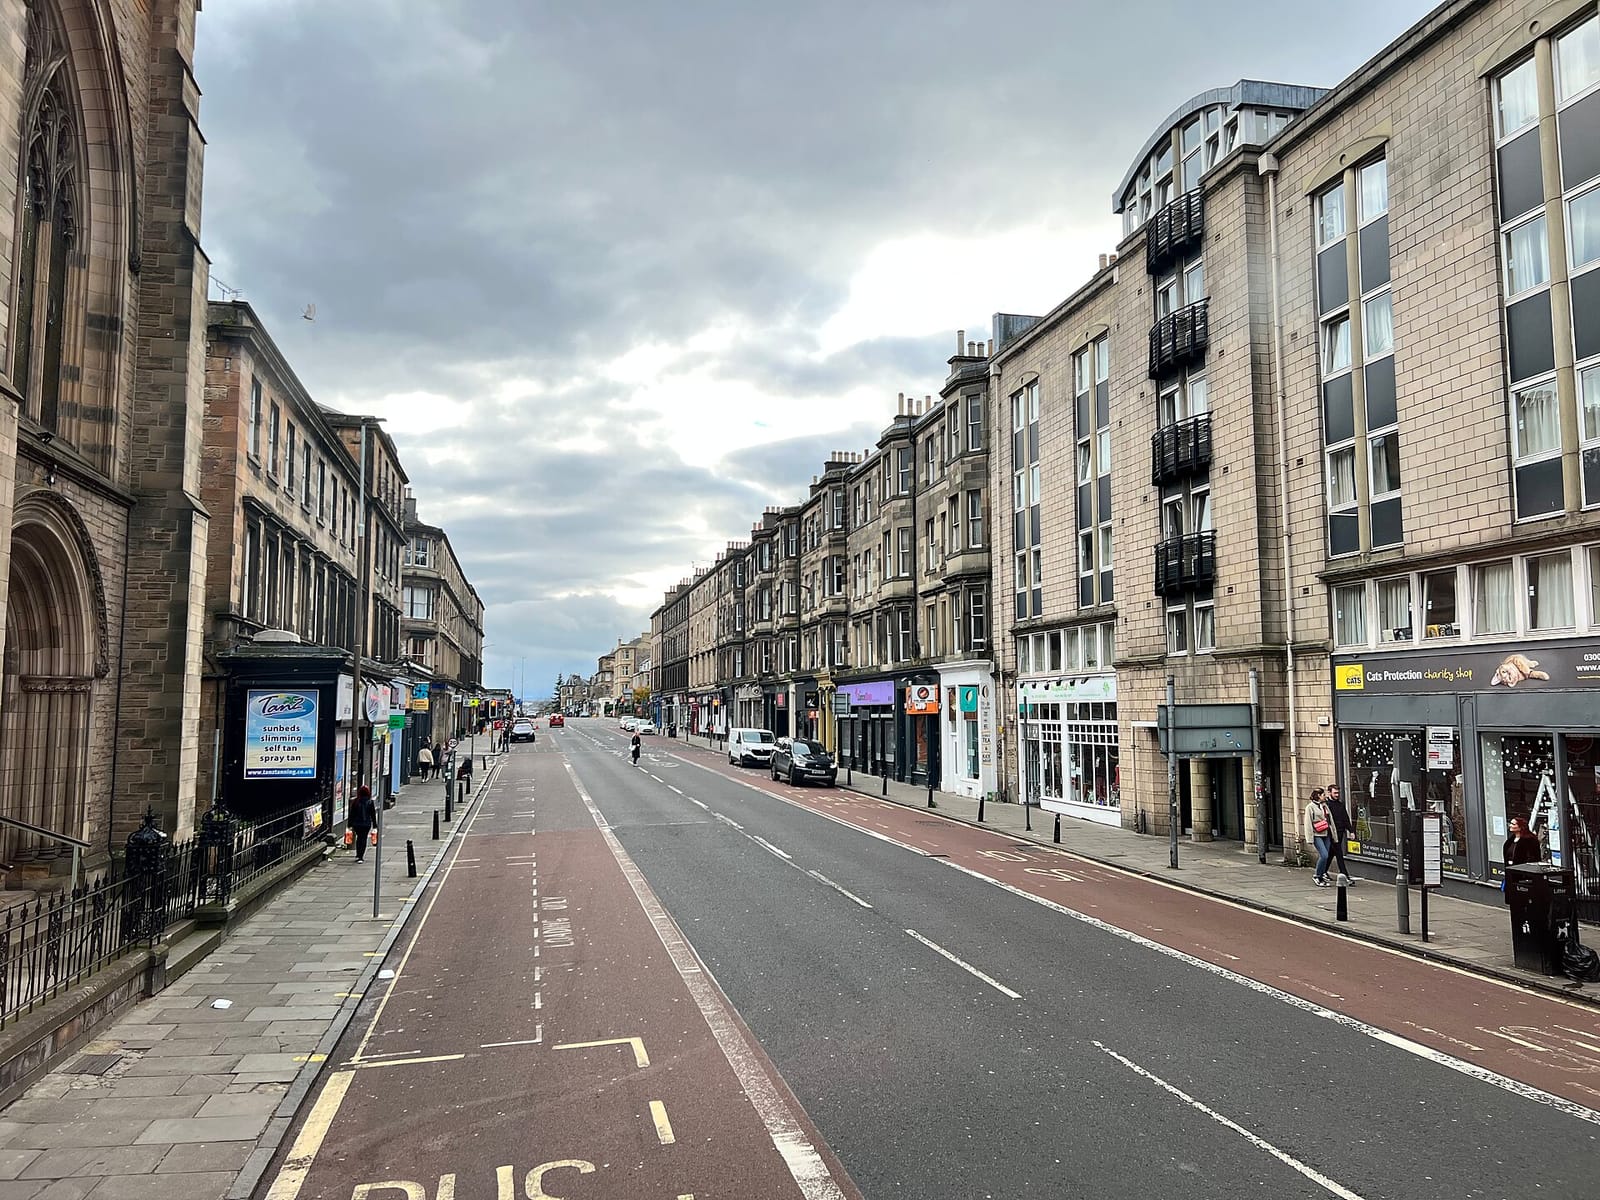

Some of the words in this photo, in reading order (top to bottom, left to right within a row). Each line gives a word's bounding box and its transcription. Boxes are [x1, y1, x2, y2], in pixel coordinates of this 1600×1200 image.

[1367, 671, 1383, 682] Cats
[1384, 669, 1422, 681] Protection
[1424, 668, 1454, 682] charity
[1456, 667, 1473, 681] shop
[263, 724, 300, 732] sunbeds
[261, 735, 302, 744] slimming
[264, 744, 281, 752] self
[260, 755, 284, 763] spray
[286, 754, 301, 762] tan
